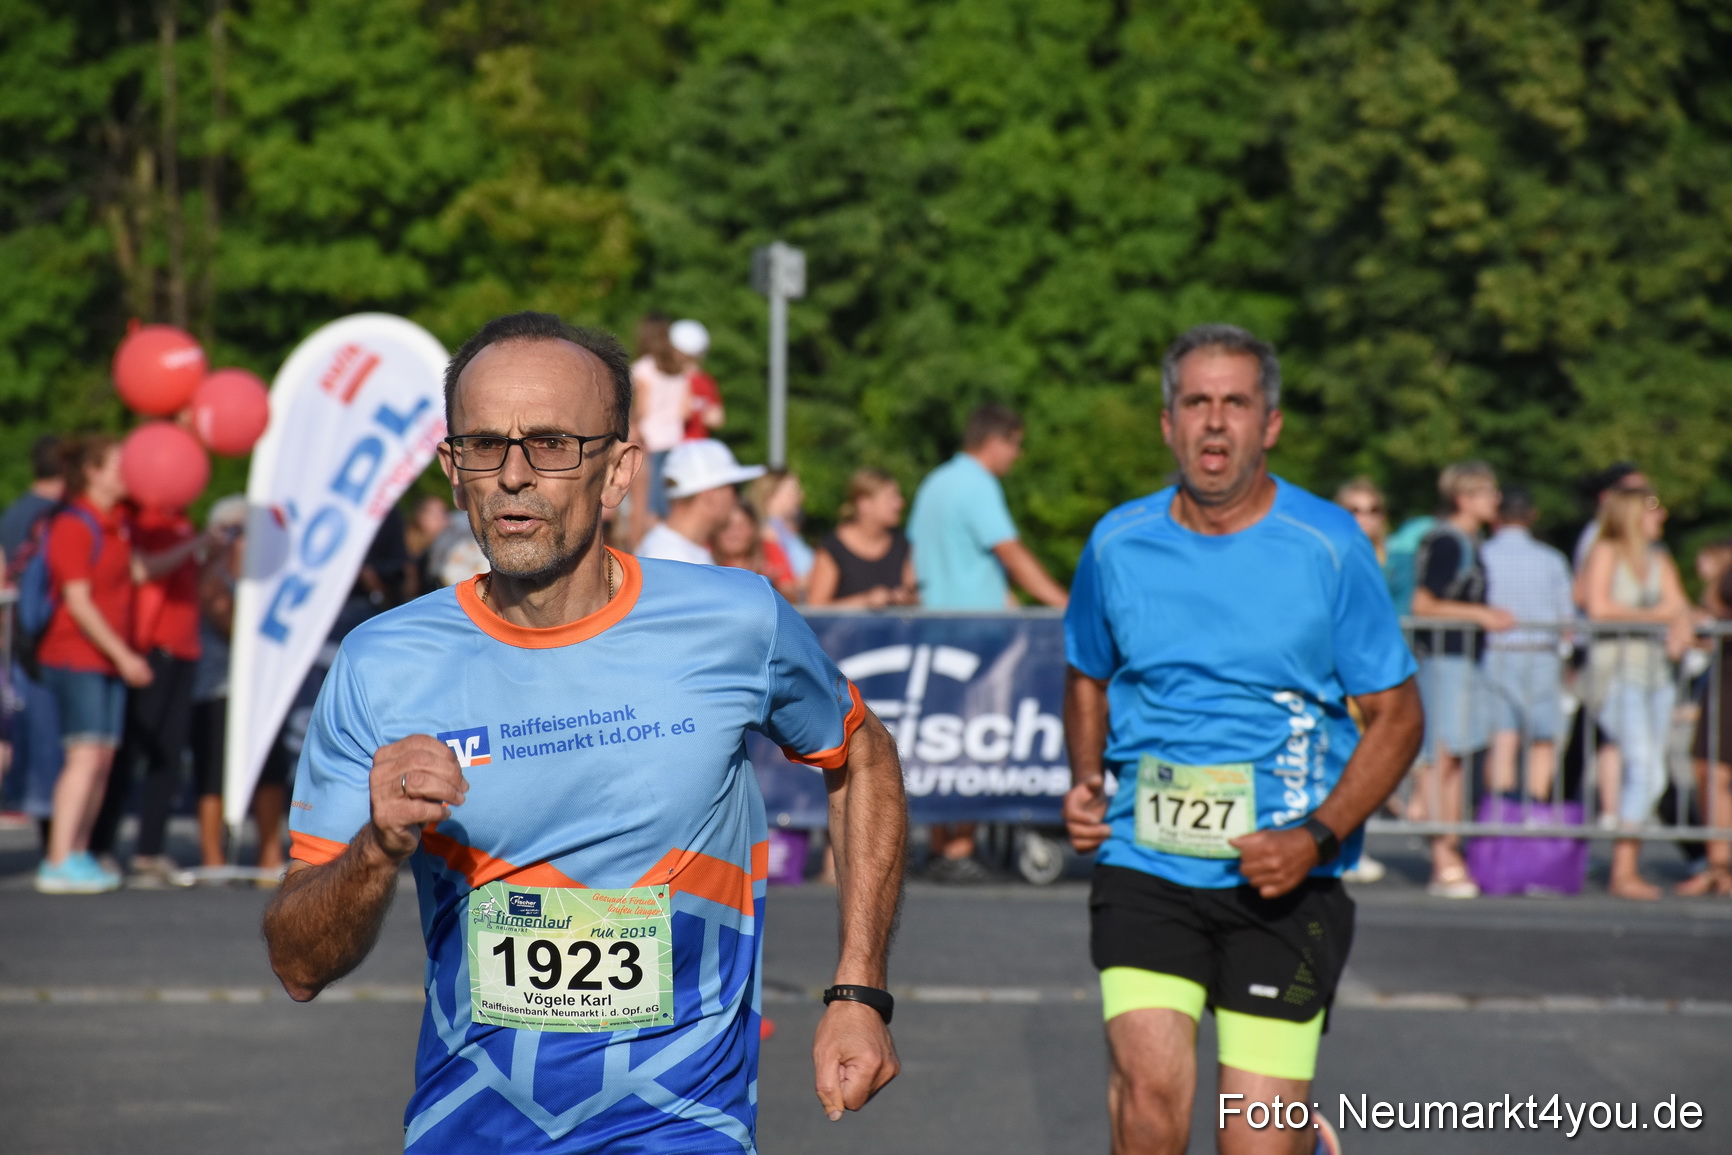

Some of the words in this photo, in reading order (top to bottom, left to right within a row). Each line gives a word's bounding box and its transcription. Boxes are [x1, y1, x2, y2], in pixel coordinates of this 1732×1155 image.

[500, 704, 637, 739] Raiffeisenbank
[502, 732, 594, 760] Neumarkt
[671, 717, 696, 736] eG
[904, 765, 1073, 797] UTOMOB
[1149, 793, 1235, 830] 1727
[592, 892, 627, 905] Gesunde
[629, 895, 657, 906] Firmen
[607, 904, 633, 915] laufen
[496, 910, 573, 929] firmenlauf
[496, 925, 528, 933] neumarkt
[590, 927, 614, 939] run
[620, 926, 657, 939] 2019
[493, 936, 643, 991] 1923
[481, 1000, 549, 1016] Raiffeisenbank
[551, 1008, 599, 1017] Neumarkt
[601, 1008, 607, 1017] i.
[610, 1008, 619, 1017] d.
[622, 1006, 643, 1016] Opf.
[645, 1004, 659, 1013] eG
[523, 991, 576, 1008] Vögele
[581, 993, 612, 1006] Karl
